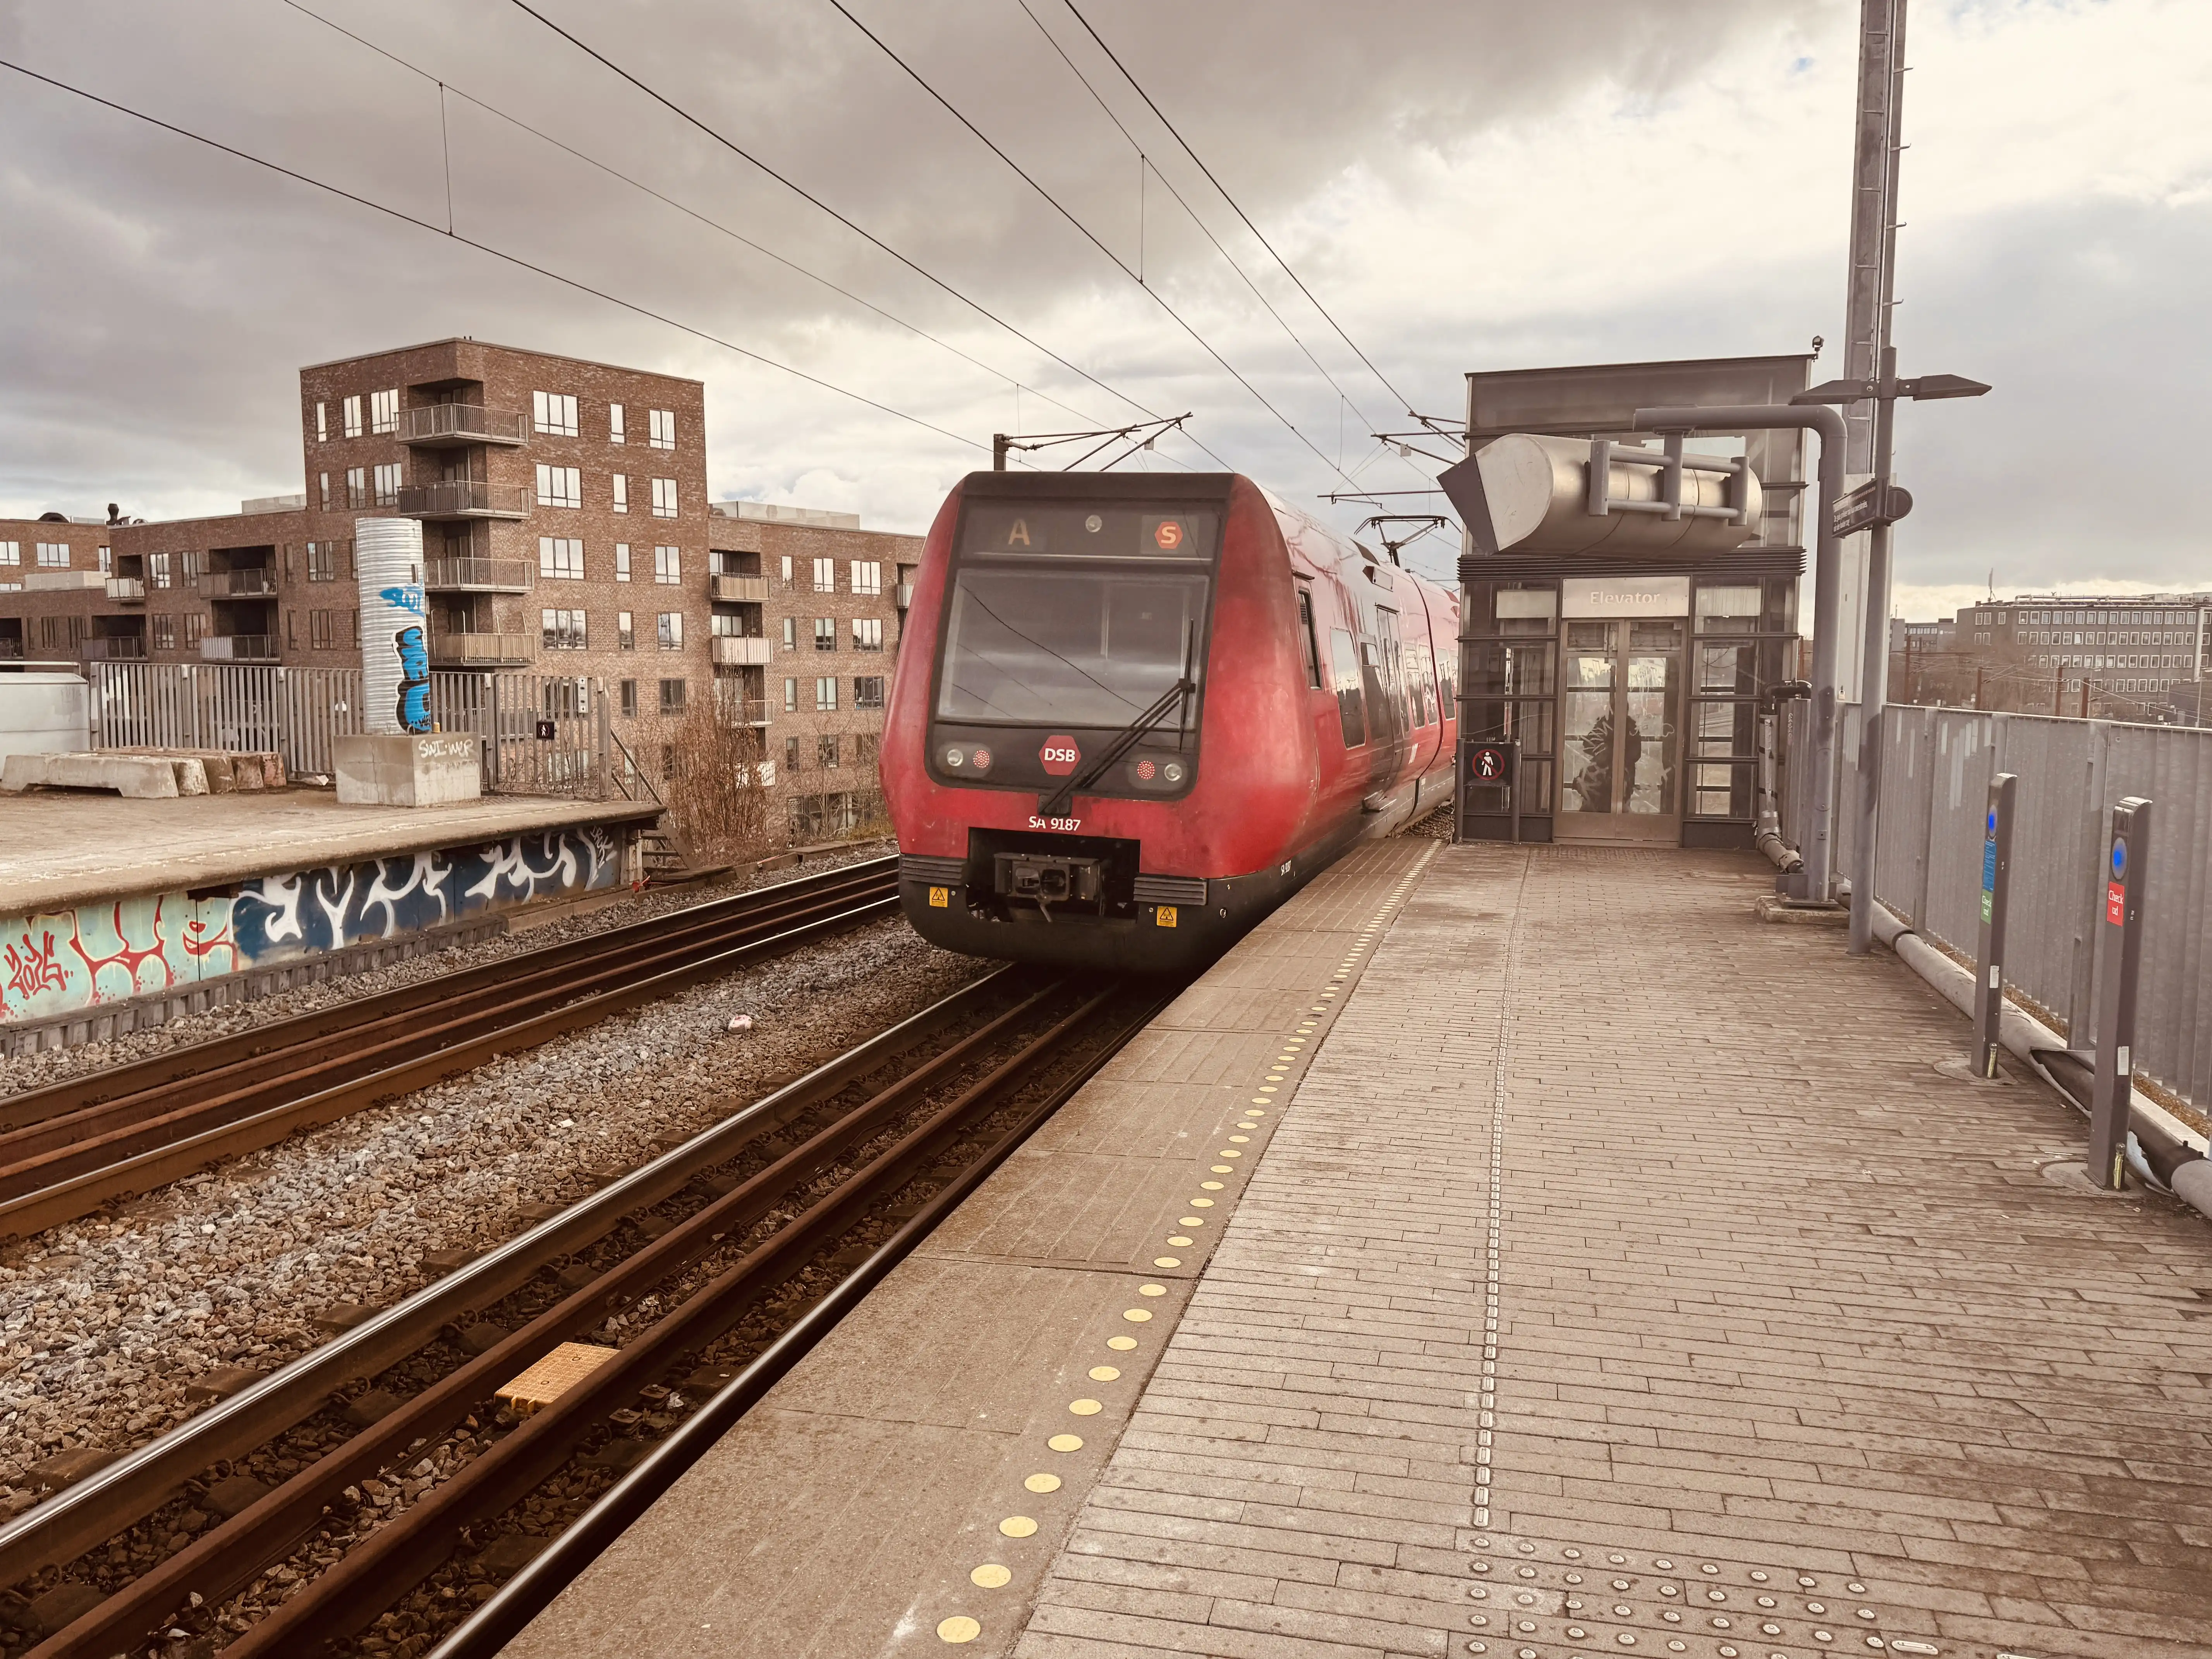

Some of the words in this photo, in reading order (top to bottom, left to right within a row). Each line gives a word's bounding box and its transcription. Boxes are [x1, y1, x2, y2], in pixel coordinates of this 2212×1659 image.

[1008, 519, 1030, 545] A
[1161, 526, 1176, 544] S
[1590, 591, 1660, 605] Elevator
[1044, 748, 1075, 762] DSB
[1029, 816, 1046, 829] SA
[1051, 818, 1081, 831] 9187
[2109, 890, 2123, 904] Check
